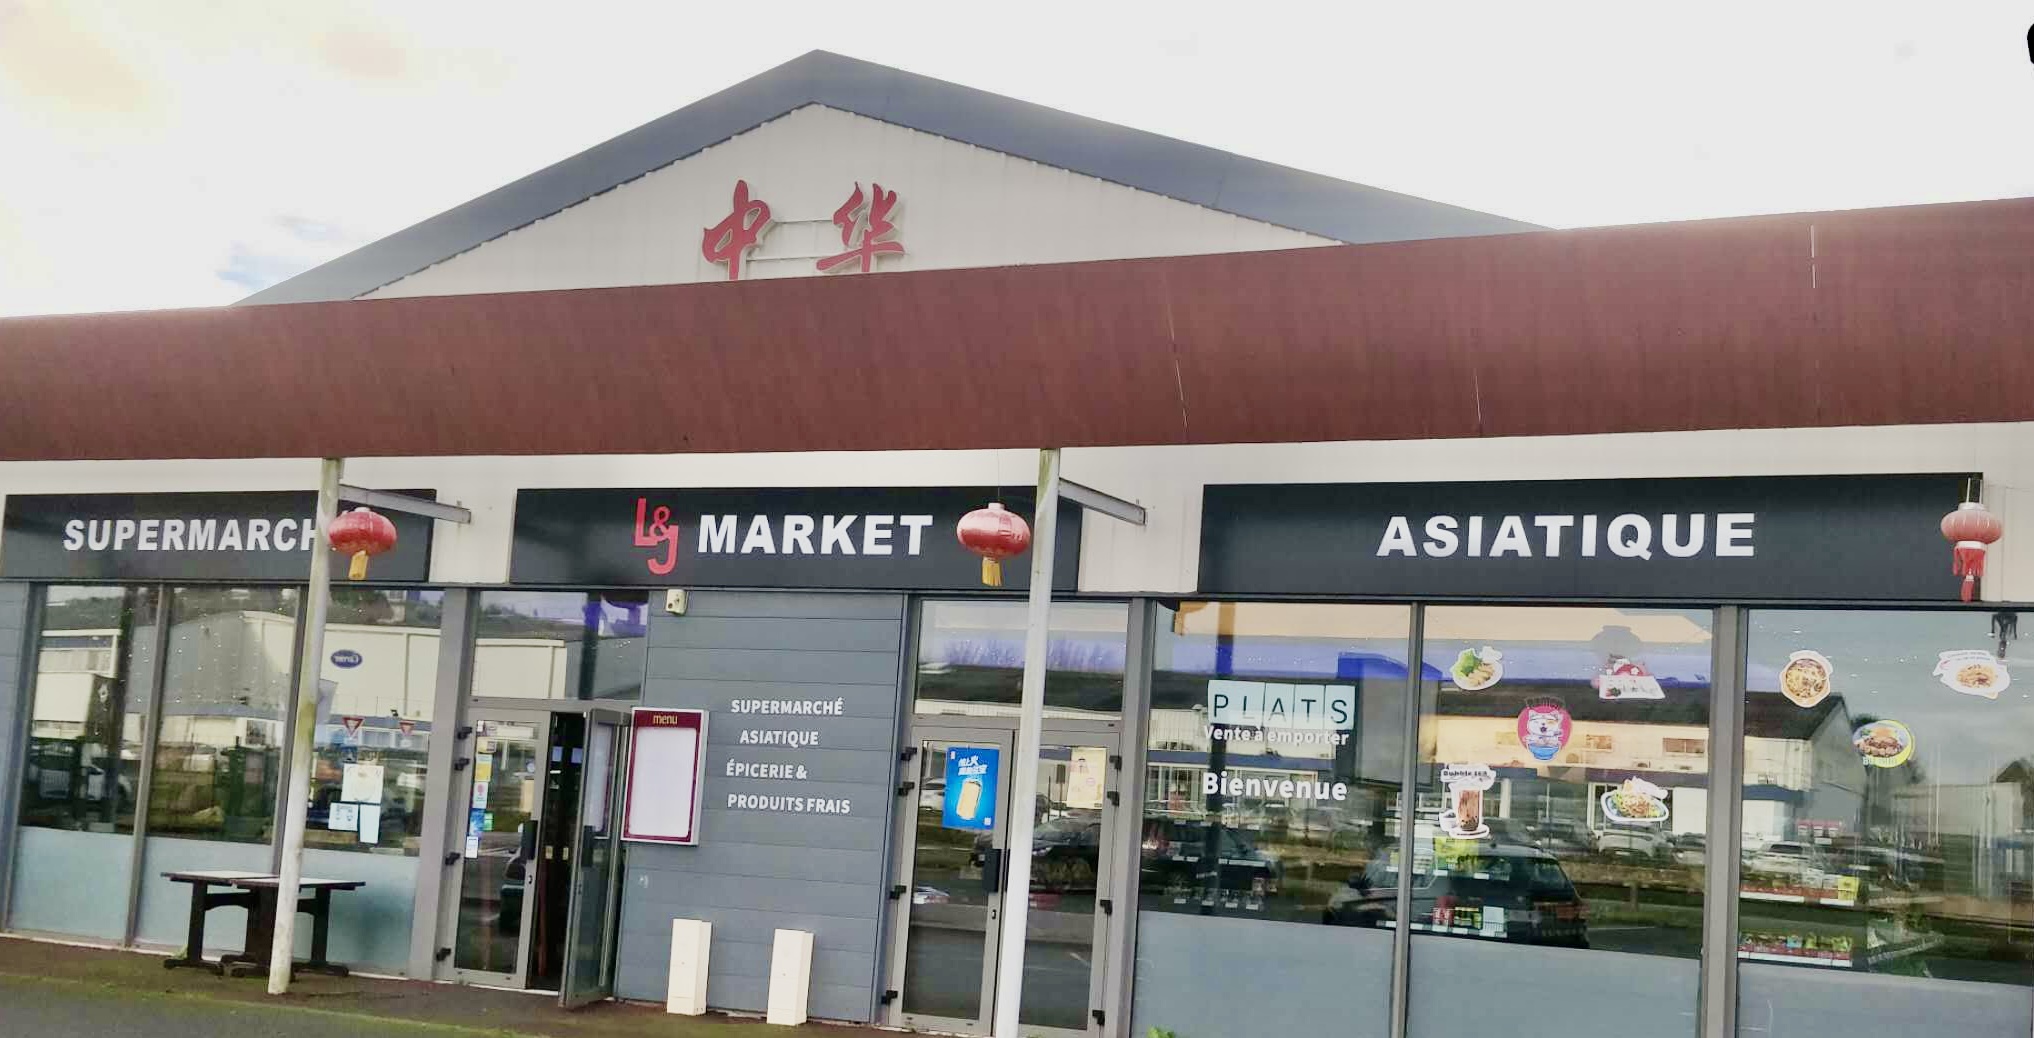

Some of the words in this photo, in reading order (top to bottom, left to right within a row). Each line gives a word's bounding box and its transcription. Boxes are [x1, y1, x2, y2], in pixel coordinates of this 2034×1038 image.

[702, 179, 905, 281] 中华
[63, 518, 317, 551] SUPERMARCH
[633, 497, 679, 576] L&J
[697, 514, 934, 556] MARKET
[1375, 513, 1755, 561] ASIATIQUE
[731, 697, 844, 715] SUPERMARCHÉ
[1213, 694, 1348, 724] PLATS
[653, 715, 678, 725] menu
[740, 730, 819, 748] ASIATIQUE
[1204, 725, 1249, 740] Vente
[1255, 726, 1264, 741] à
[1267, 730, 1350, 746] emporter
[726, 759, 794, 779] ÉPICERIE
[795, 765, 807, 780] &
[1202, 771, 1348, 801] Bienvenue
[727, 794, 804, 812] PRODUITS
[806, 799, 851, 814] FRAIS
